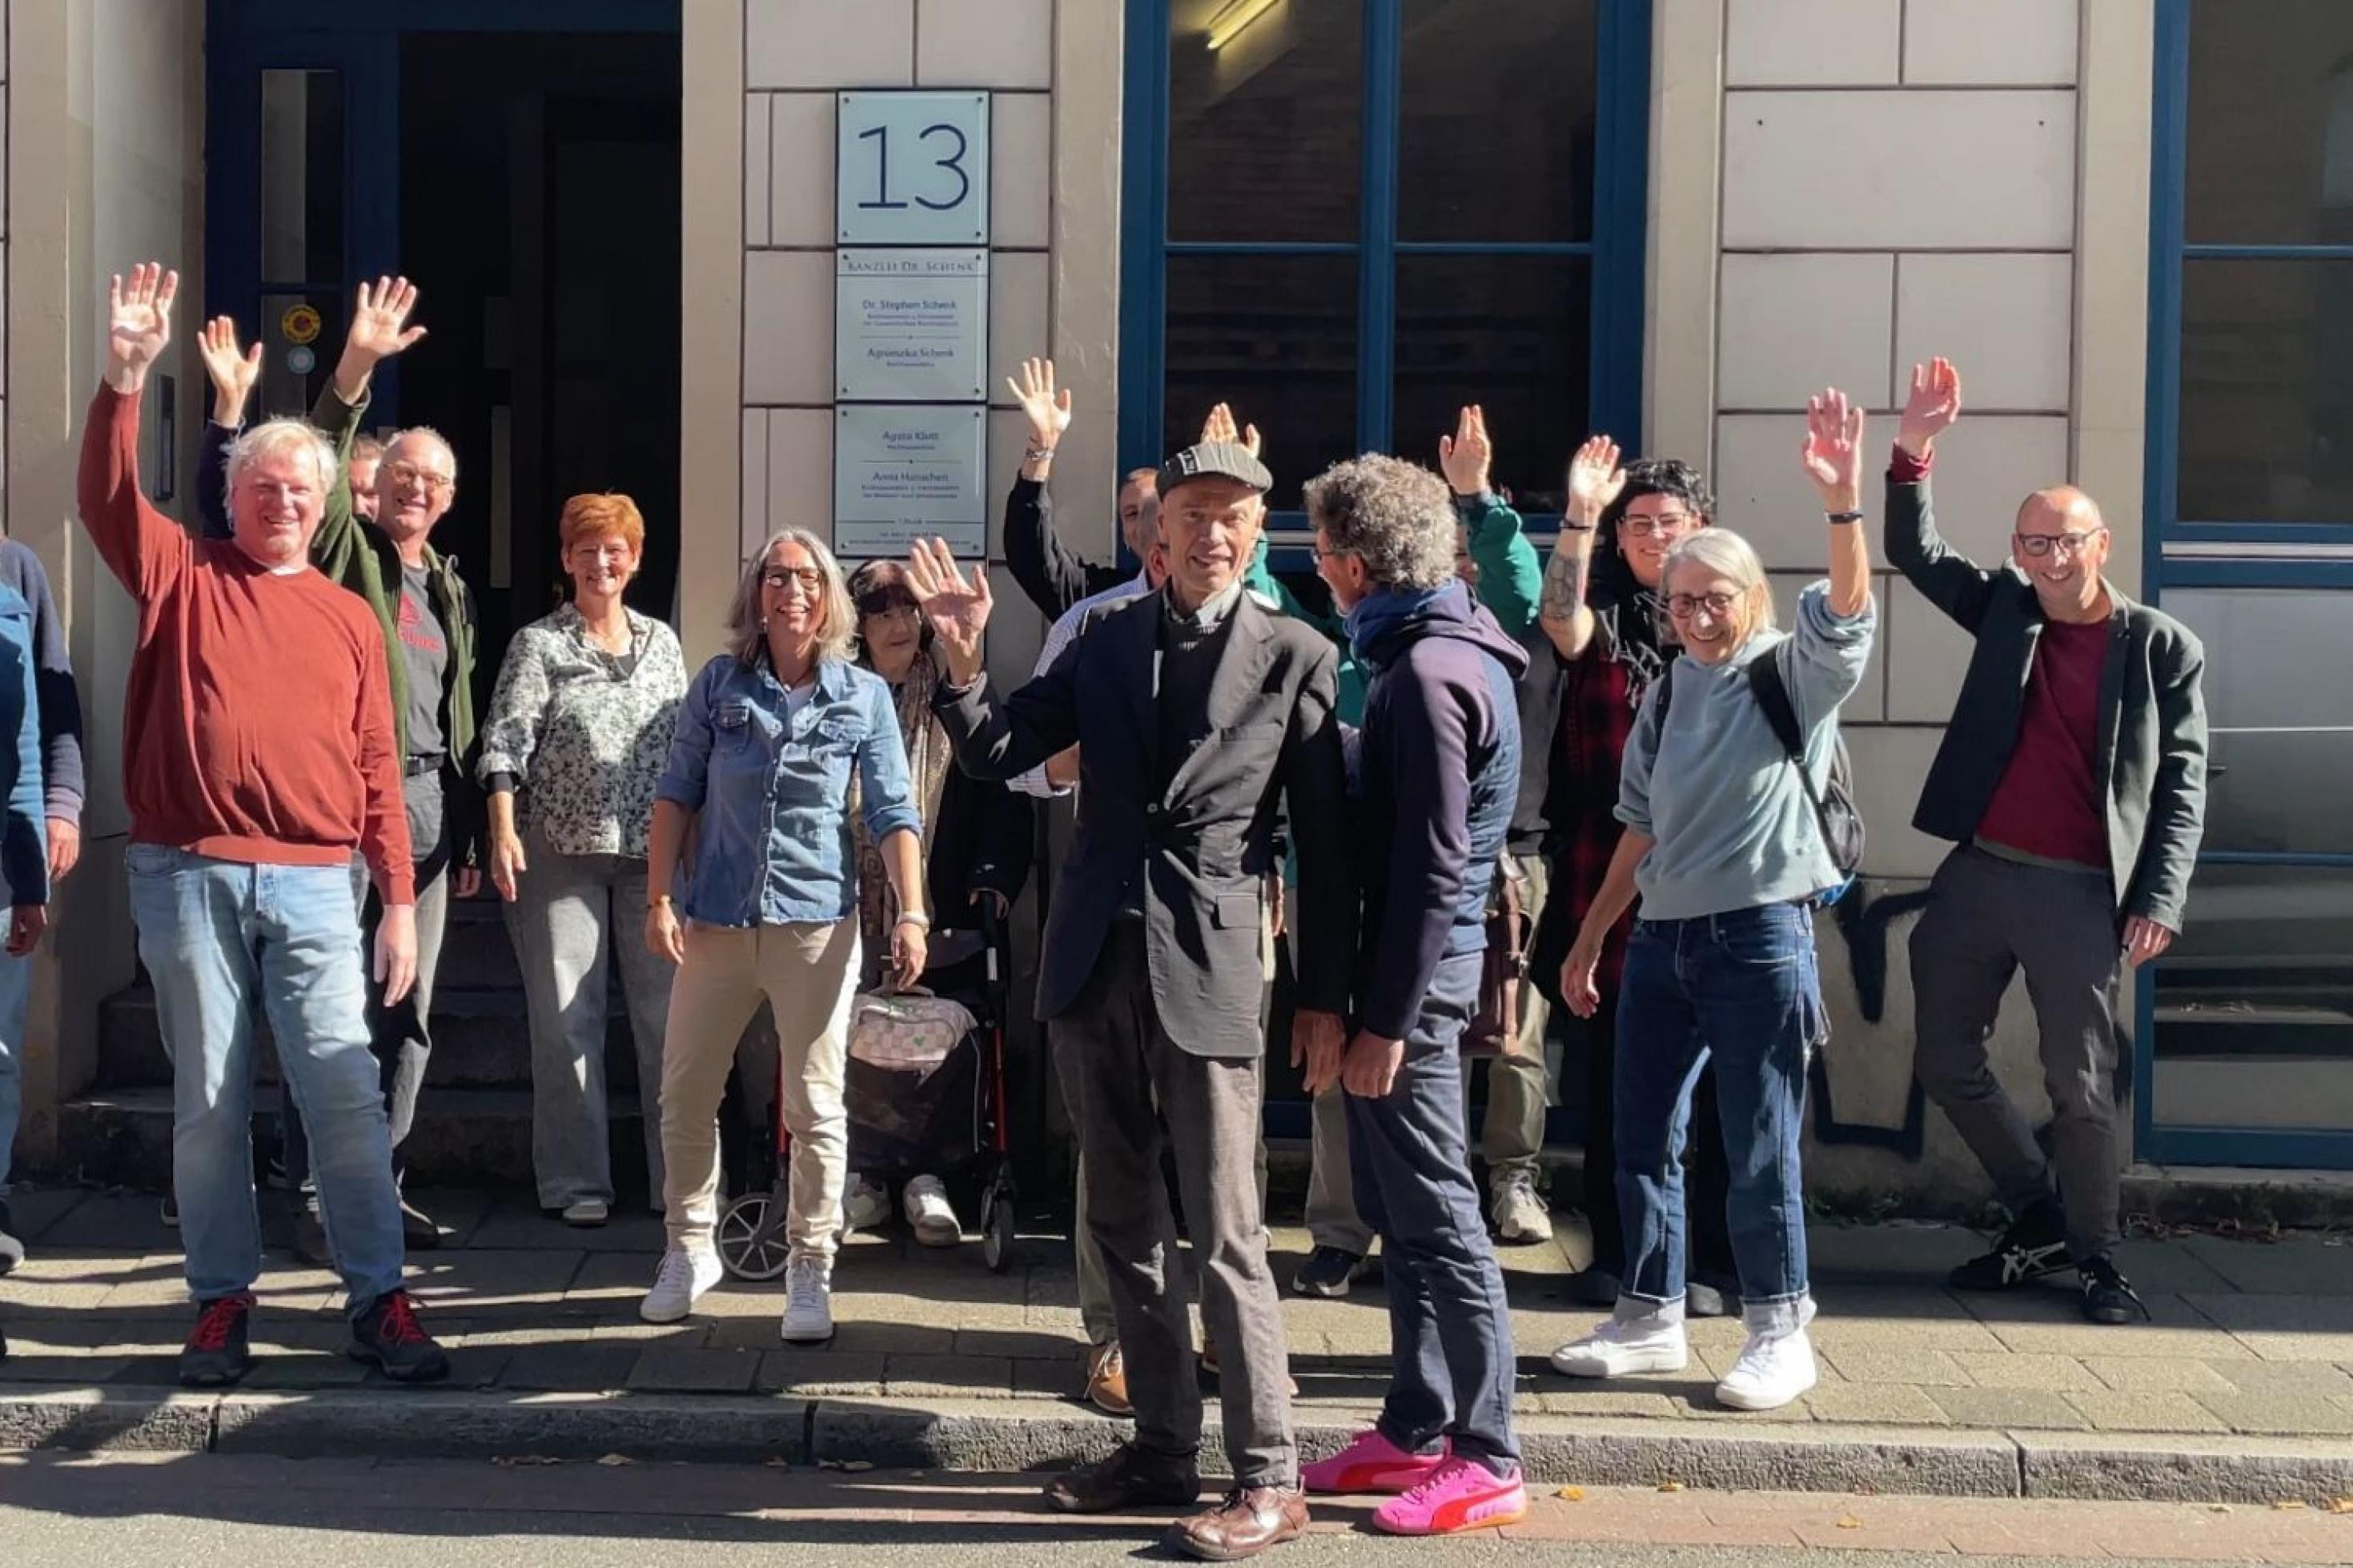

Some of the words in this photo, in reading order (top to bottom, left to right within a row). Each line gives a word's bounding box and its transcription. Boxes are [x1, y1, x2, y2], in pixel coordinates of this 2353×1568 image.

[857, 123, 969, 210] 13
[922, 300, 957, 310] Schenk
[920, 347, 954, 357] Schenk
